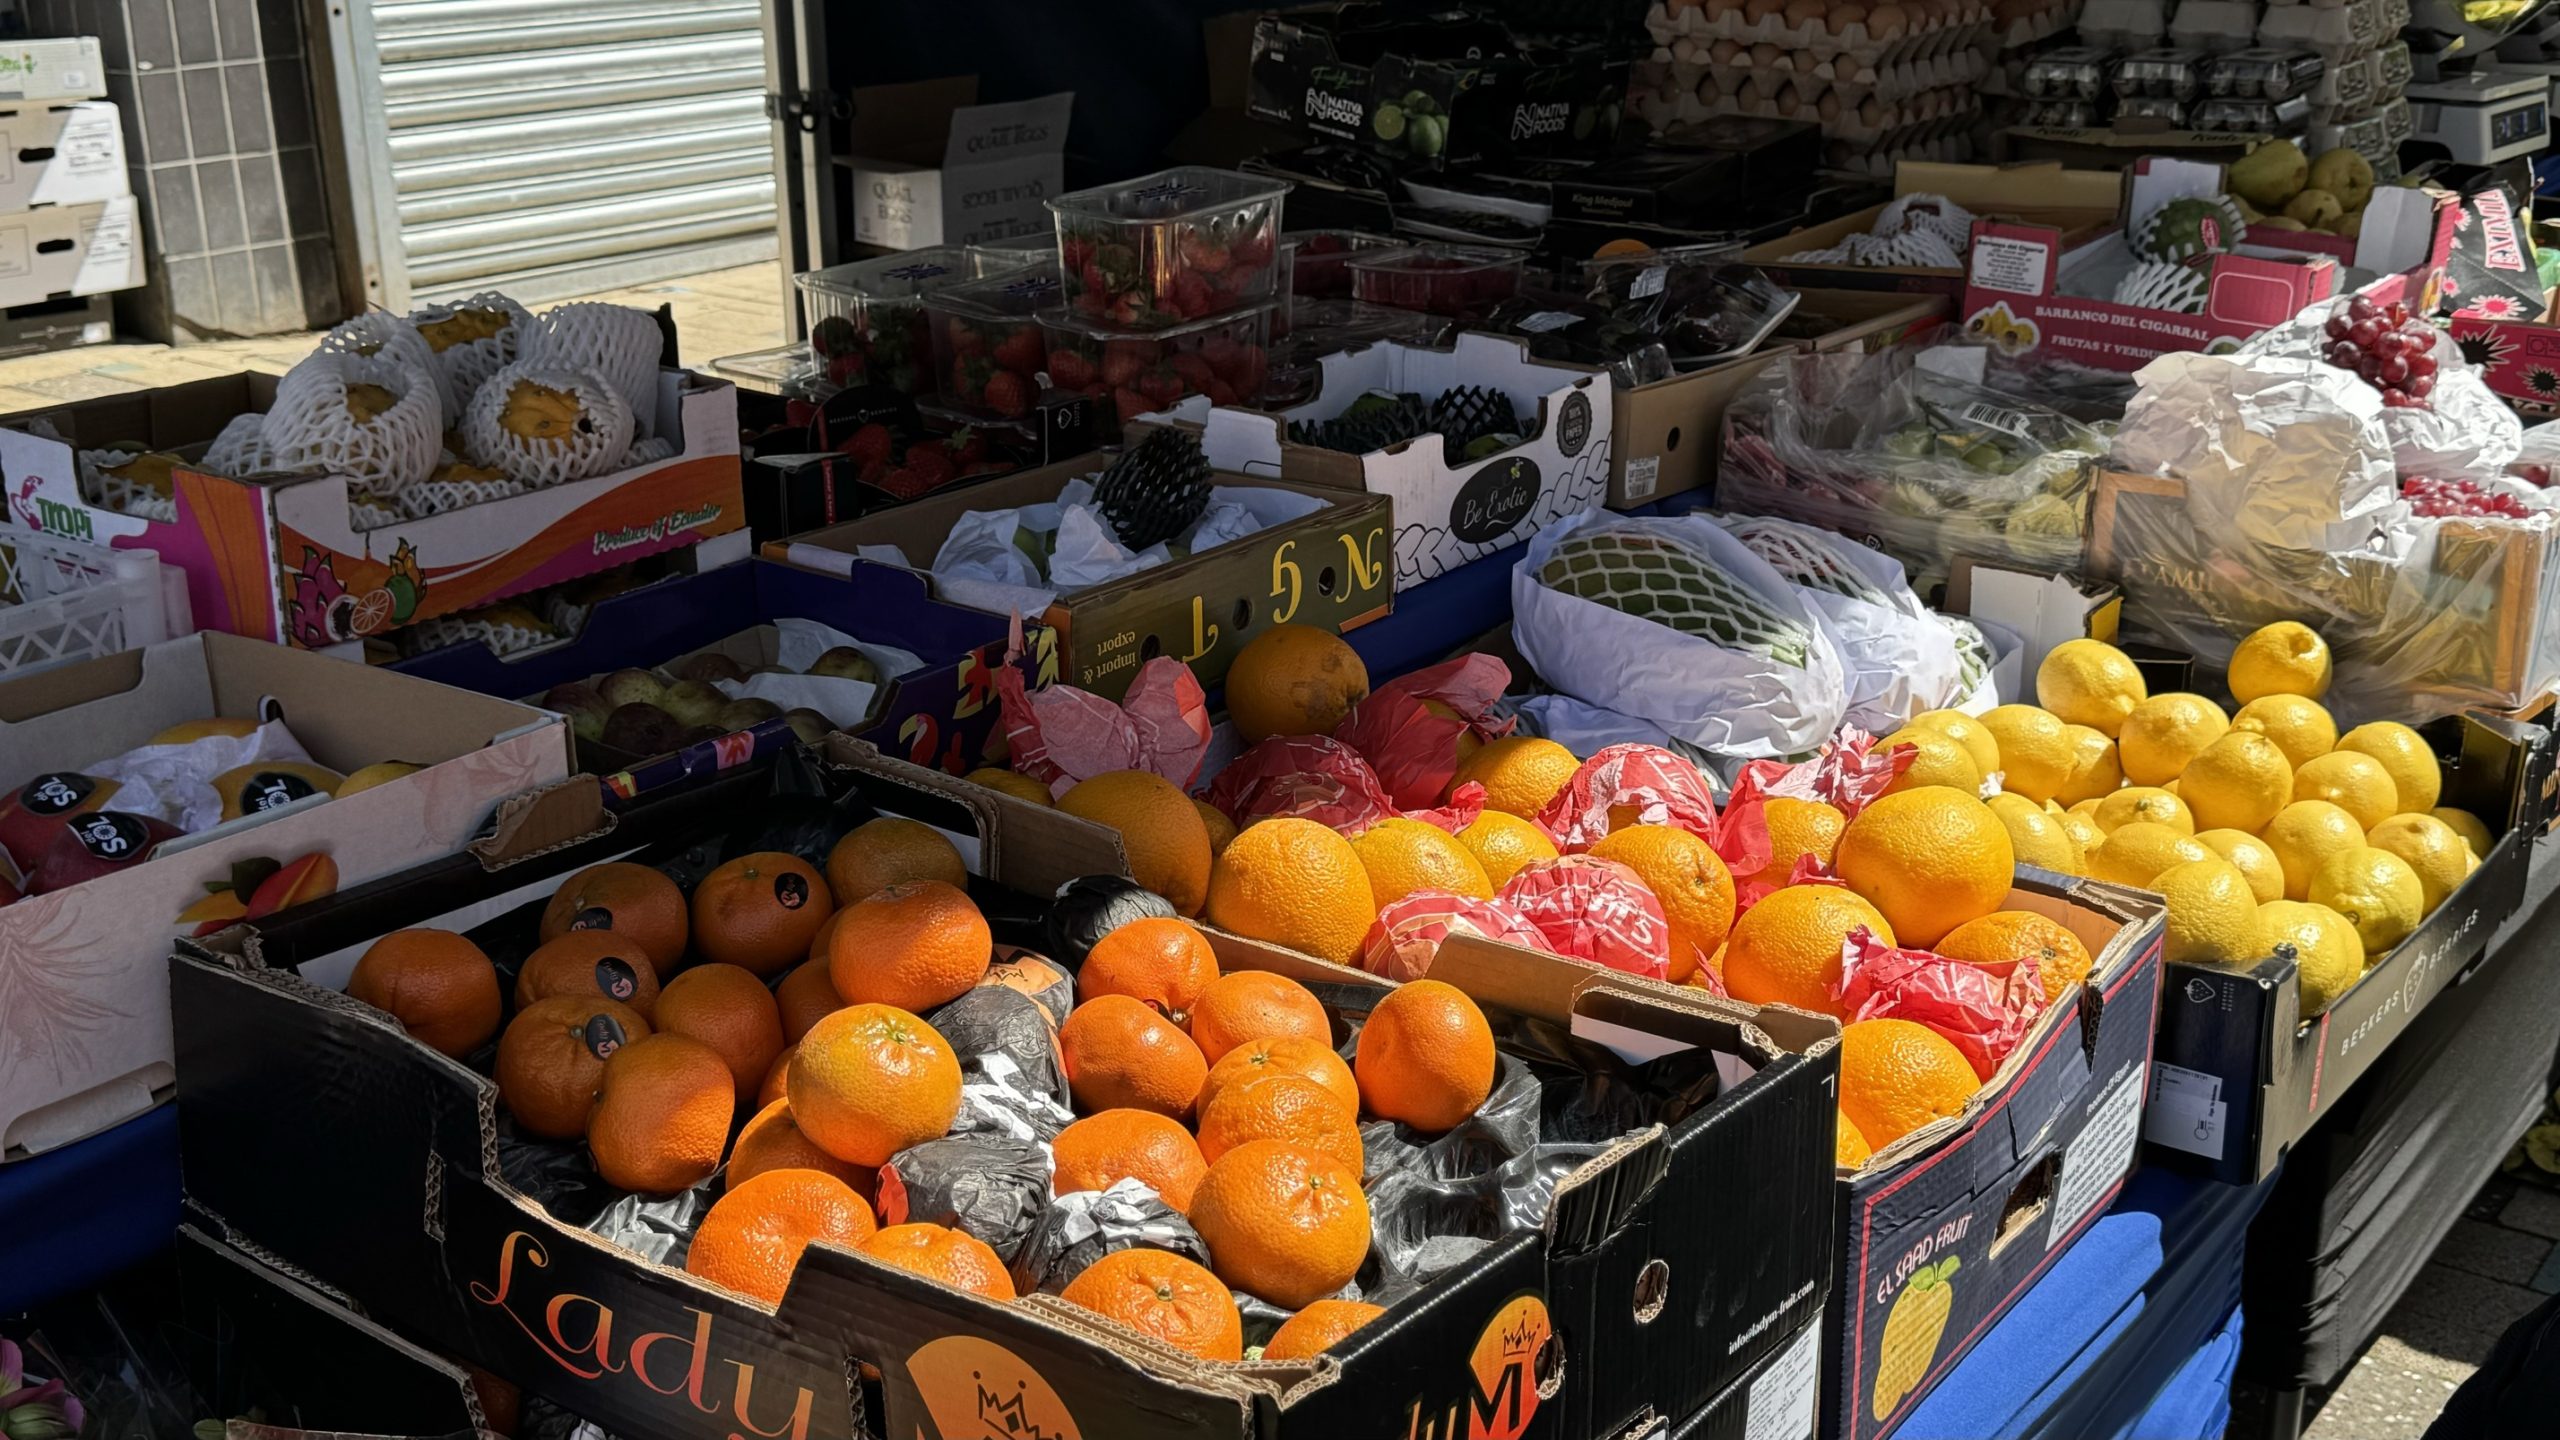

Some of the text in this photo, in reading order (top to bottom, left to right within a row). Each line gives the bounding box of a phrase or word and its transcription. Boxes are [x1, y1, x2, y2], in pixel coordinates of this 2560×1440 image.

[1326, 108, 1361, 127] FOODS
[1328, 96, 1364, 116] NATIVA
[1536, 102, 1570, 119] NATIVA
[967, 130, 1011, 153] QUAIL
[1014, 126, 1049, 145] EGGS
[1533, 117, 1566, 134] FOODS
[873, 182, 915, 205] QUAIL
[962, 180, 1043, 210] QUAIL EGGS
[1572, 192, 1595, 208] King
[878, 205, 912, 225] EGGS
[2035, 305, 2211, 342] BARRANCO DEL CIGARRAL
[2050, 334, 2165, 360] FRUTAS Y VERDU
[1464, 486, 1528, 530] Be Exotic
[593, 503, 722, 555] Produce of Ecuador
[1334, 527, 1383, 603] N
[1096, 631, 1136, 657] export
[1181, 595, 1219, 664] T
[1082, 652, 1136, 685] import &
[40, 777, 78, 807] SOL
[264, 778, 291, 808] OL
[87, 815, 128, 854] SOL
[2341, 909, 2480, 1057] BEEKERS BERRIES
[1876, 1212, 1973, 1305] EL SAAD FRUIT
[1728, 1279, 1815, 1356] info@ladym-fruit.com
[470, 1236, 814, 1440] Lady
